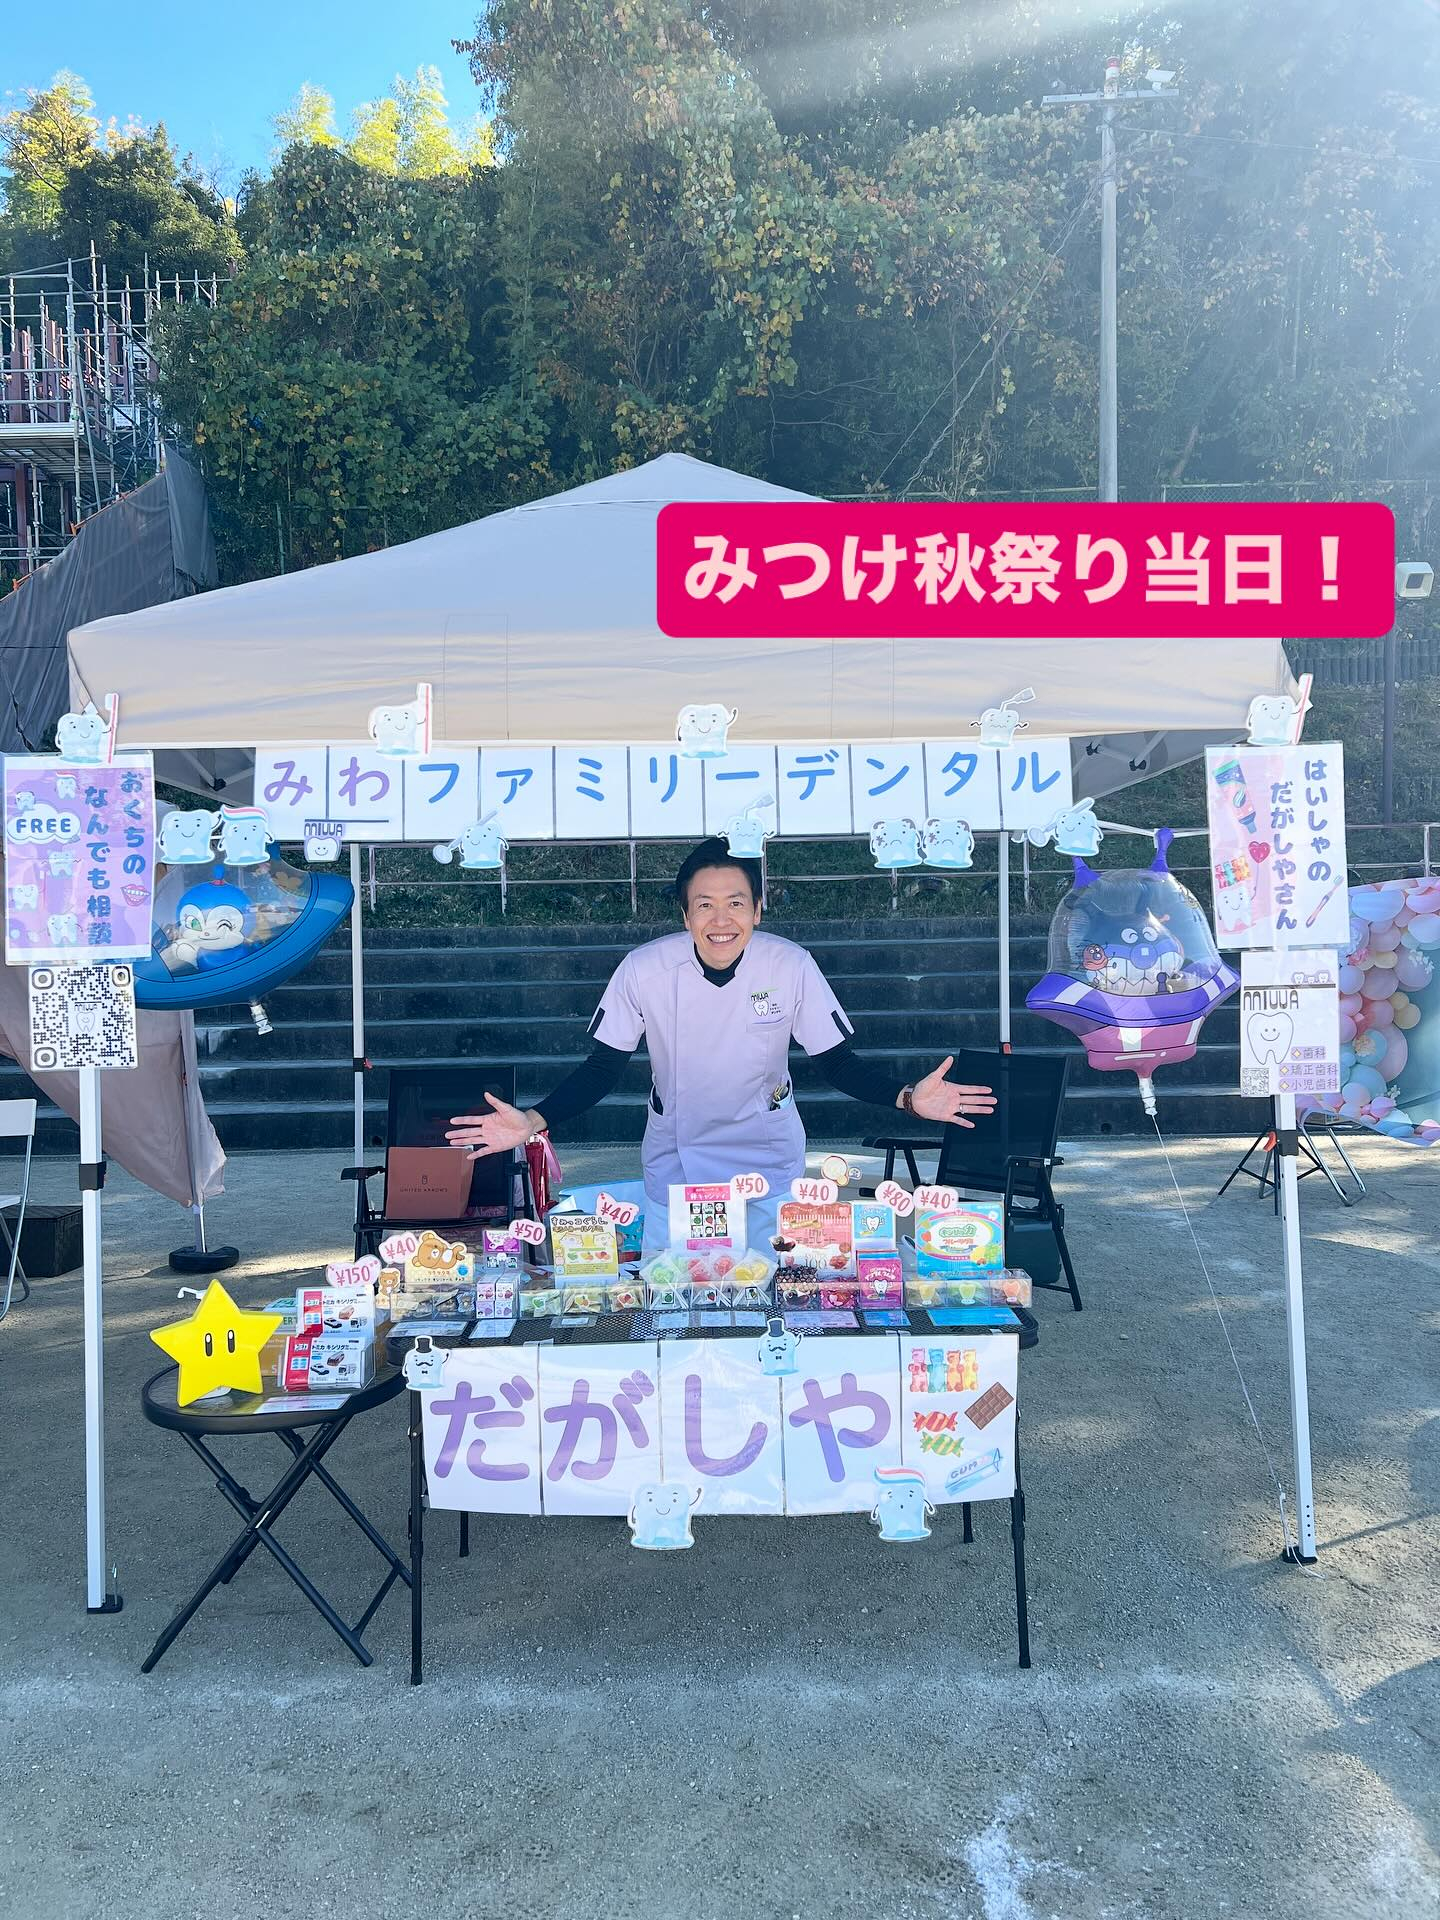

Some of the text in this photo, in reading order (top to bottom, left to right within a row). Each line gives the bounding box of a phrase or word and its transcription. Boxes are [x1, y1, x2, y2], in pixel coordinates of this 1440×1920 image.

[264, 749, 1061, 806] みわファミリーデンタル
[16, 818, 71, 834] FREE
[121, 771, 146, 875] おくちの
[1304, 759, 1332, 882] はいしゃの
[85, 785, 112, 945] なんでも相談
[1243, 989, 1299, 1011] MIWA
[1303, 1048, 1326, 1059] 歯科
[1291, 1065, 1338, 1076] 矯正歯科
[1291, 1079, 1338, 1091] 小児歯科
[735, 1177, 764, 1194] ¥50
[799, 1183, 830, 1201] ¥40
[882, 1184, 911, 1212] ¥80
[920, 1190, 951, 1209] ¥40
[601, 1202, 631, 1224] ¥40
[515, 1222, 543, 1242] ¥50
[385, 1237, 416, 1259] ¥40
[335, 1265, 371, 1286] ¥150
[430, 1370, 892, 1482] だがしや
[951, 1461, 978, 1479] GUM
